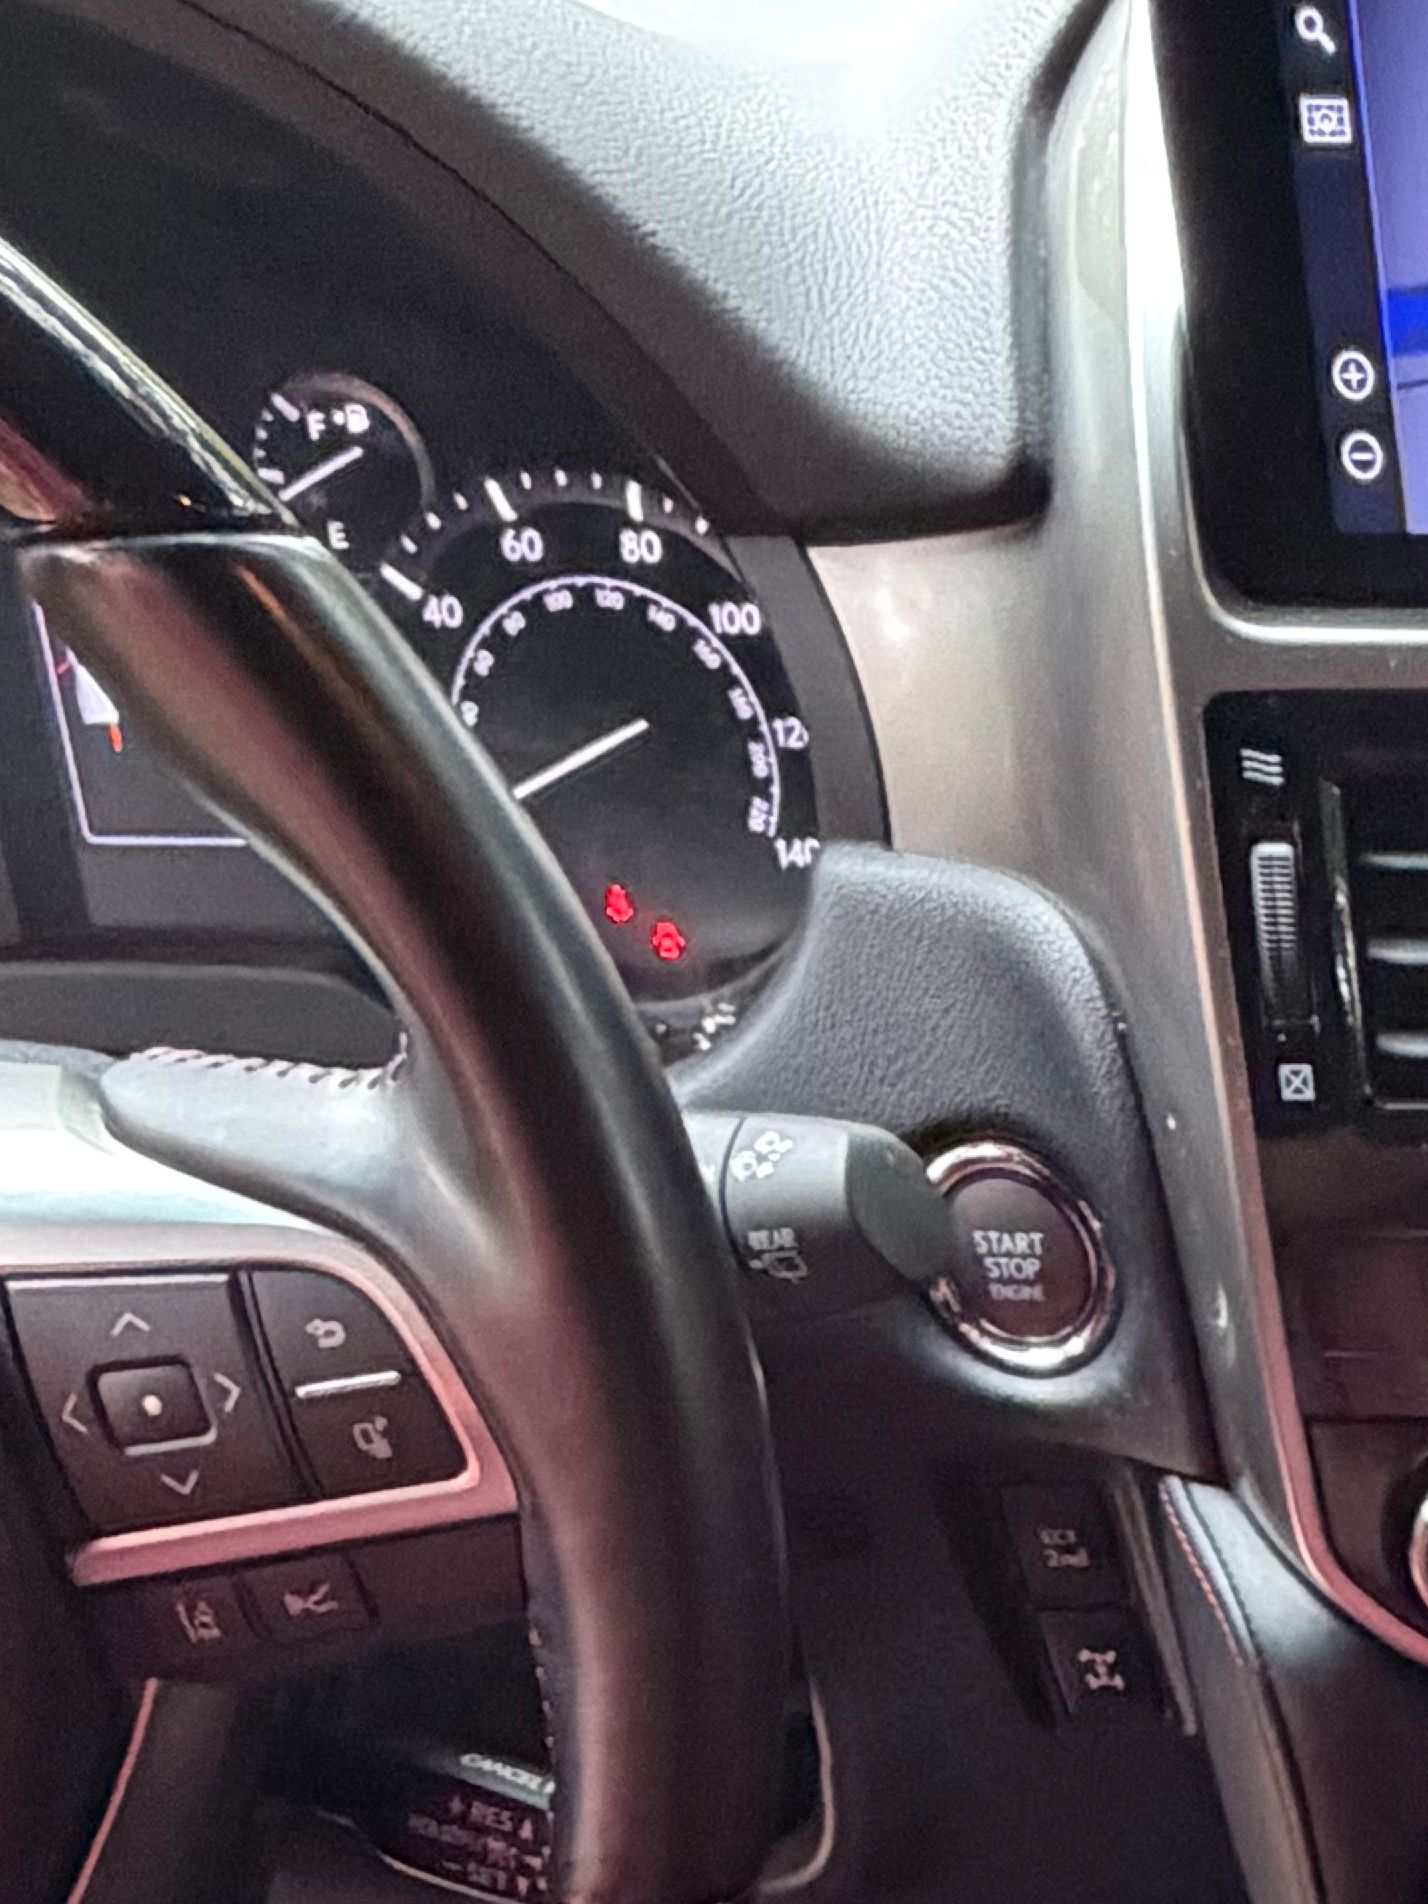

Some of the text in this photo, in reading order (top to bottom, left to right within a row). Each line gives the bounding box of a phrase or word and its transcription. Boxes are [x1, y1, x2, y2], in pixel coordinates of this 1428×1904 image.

[307, 410, 325, 441] F
[327, 521, 349, 549] E
[500, 527, 543, 562] 60
[619, 528, 662, 563] 80
[422, 594, 463, 628] 40
[708, 602, 762, 635] 100
[973, 1231, 1044, 1255] START
[983, 1257, 1040, 1279] STOP
